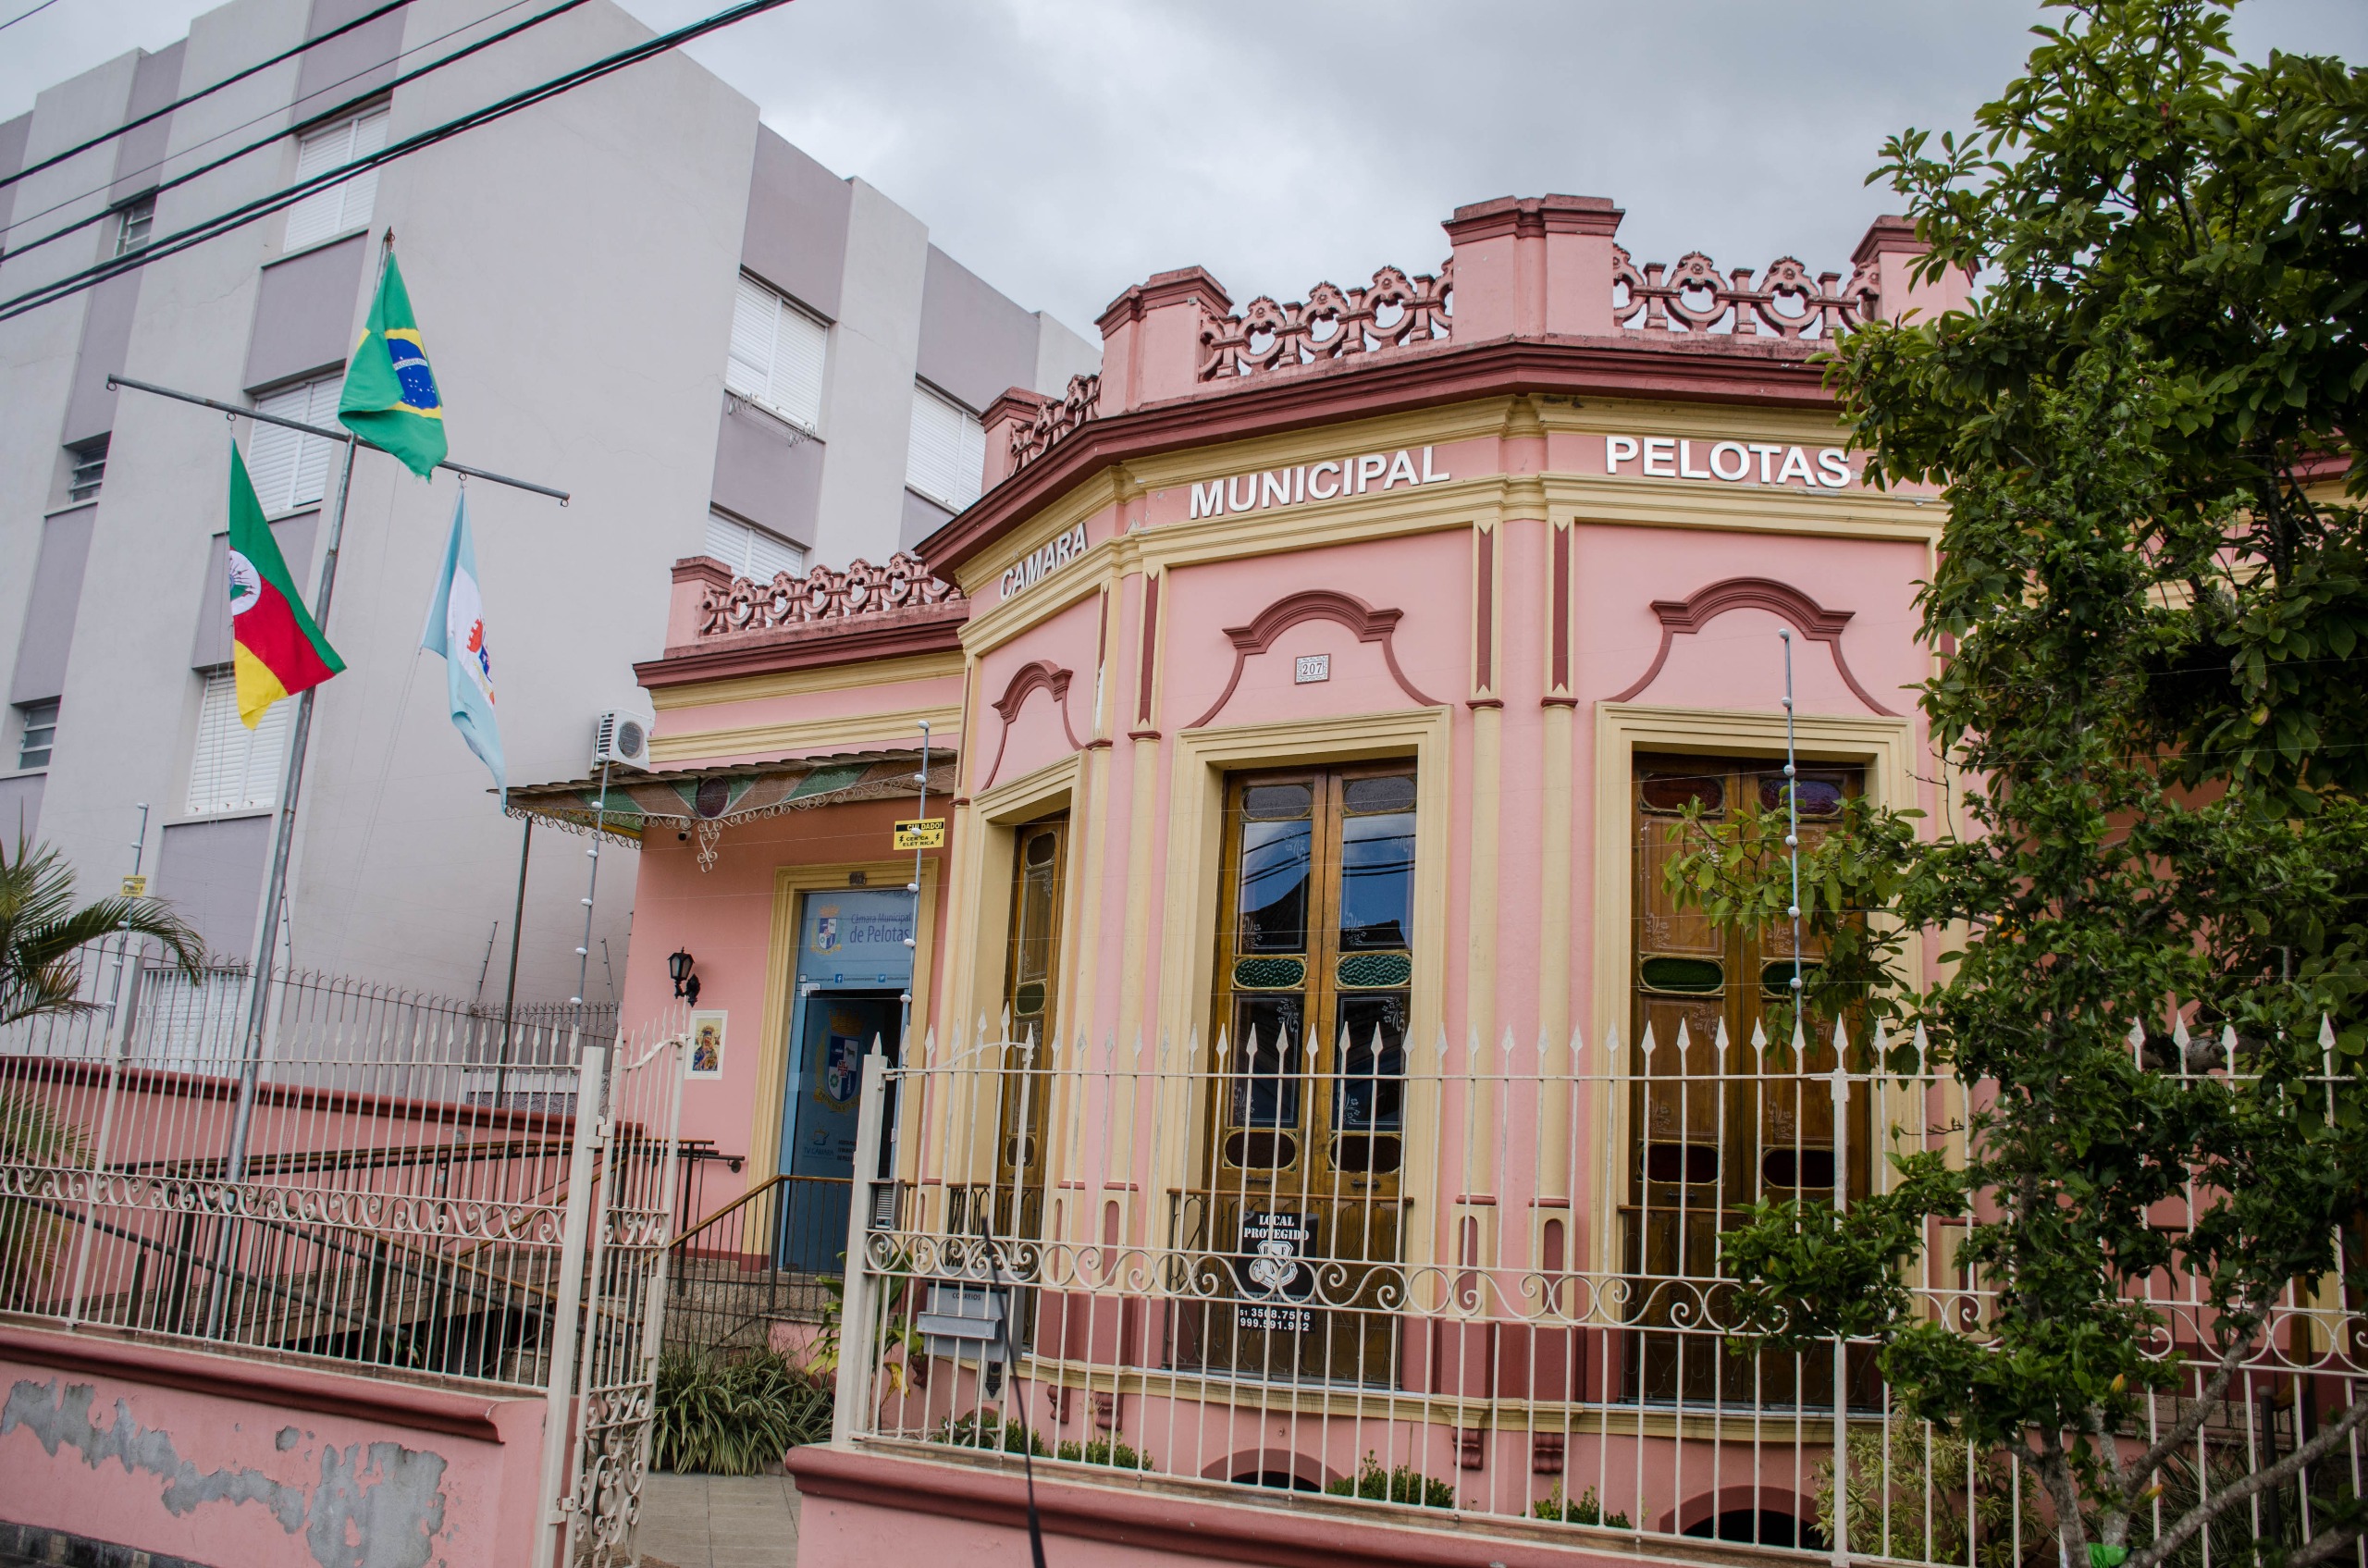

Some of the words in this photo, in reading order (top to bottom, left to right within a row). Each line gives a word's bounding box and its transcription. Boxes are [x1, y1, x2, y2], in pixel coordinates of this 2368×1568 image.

[1000, 522, 1088, 601] CAMARA
[1190, 445, 1450, 519] MUNICIPAL
[1605, 435, 1852, 488] PELOTAS
[1302, 662, 1323, 674] 207
[851, 913, 877, 924] Câmara
[877, 912, 912, 925] Municipal
[849, 925, 864, 943] de
[867, 925, 910, 943] Pelotas
[1259, 1215, 1295, 1226] LOCAL
[1251, 1307, 1311, 1321] 358.756
[1240, 1317, 1310, 1331] 999.591.92
